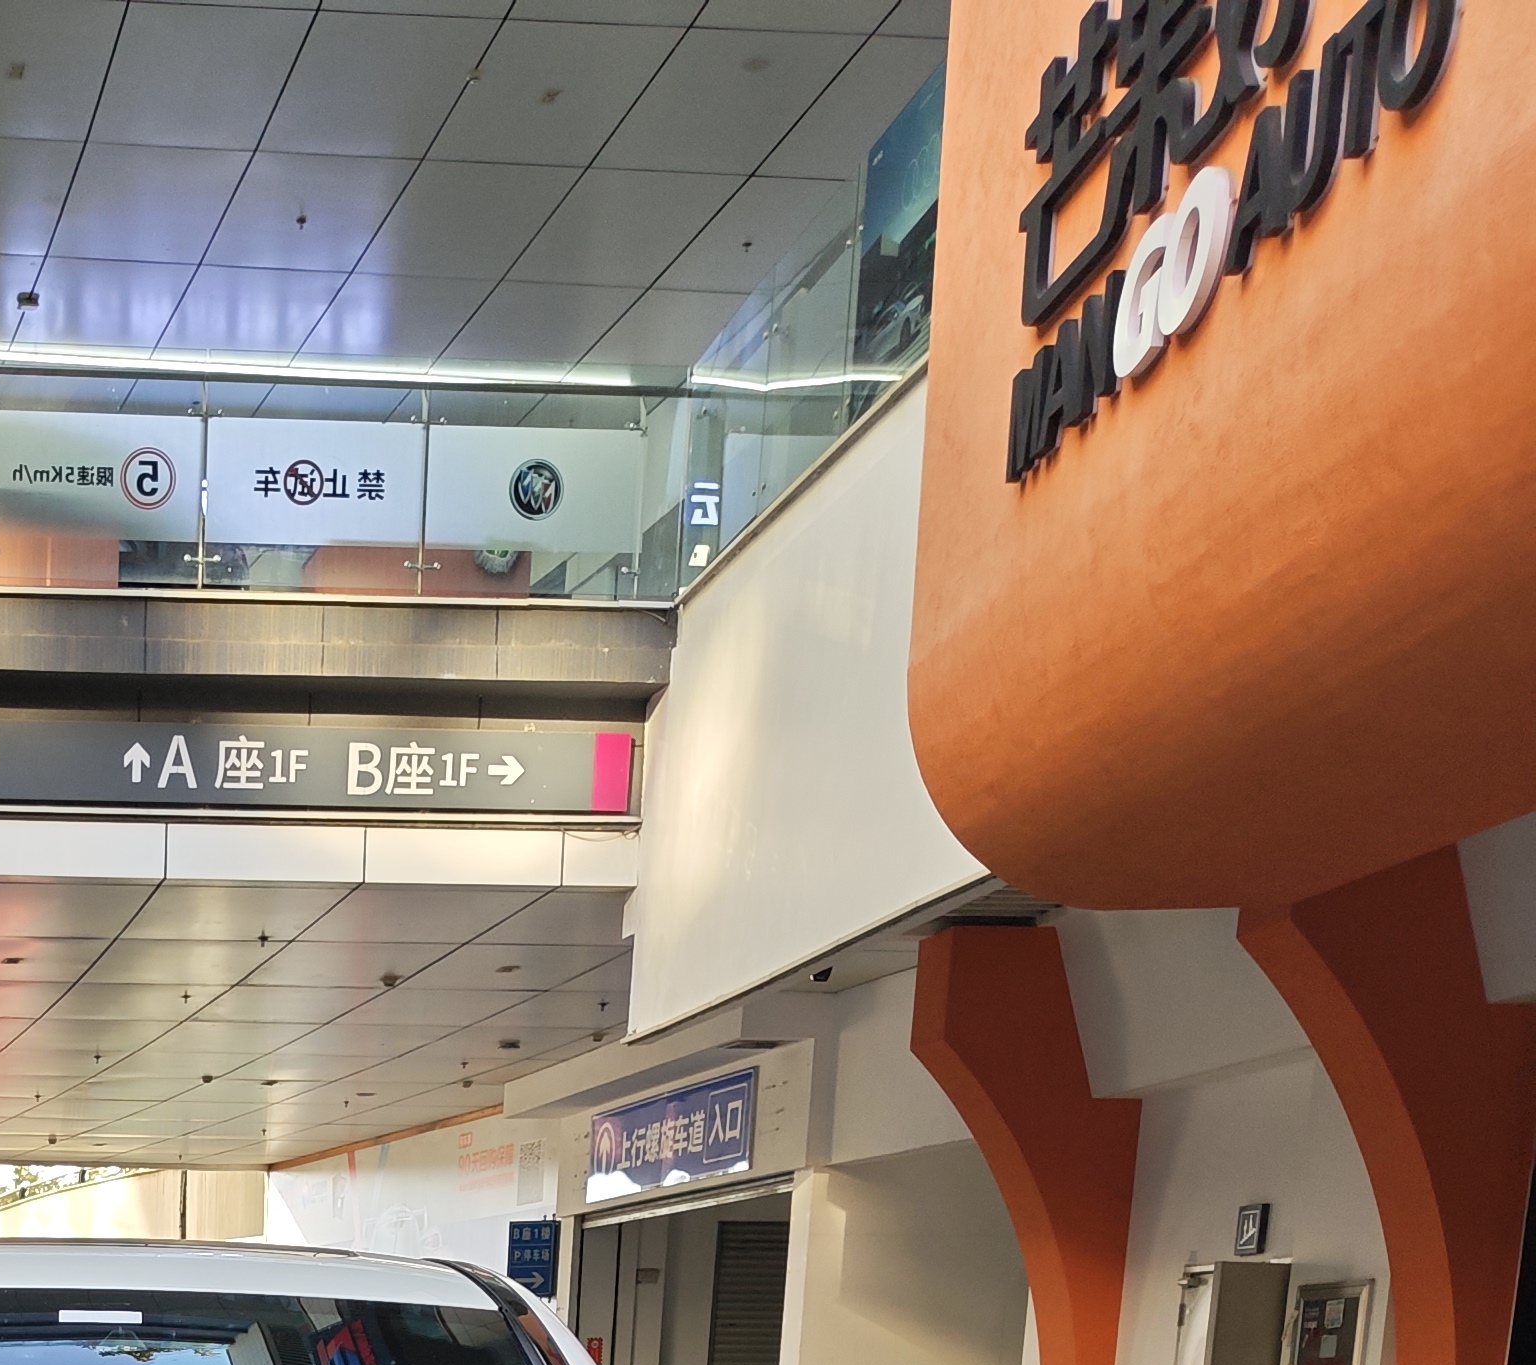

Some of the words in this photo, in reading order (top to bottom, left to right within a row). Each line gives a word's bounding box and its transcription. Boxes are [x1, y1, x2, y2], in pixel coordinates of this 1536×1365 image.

[1006, 165, 1234, 484] MANGO
[1222, 0, 1458, 275] AUTO
[616, 1109, 706, 1170] 上行螺旋车道
[708, 1100, 743, 1146] 入口
